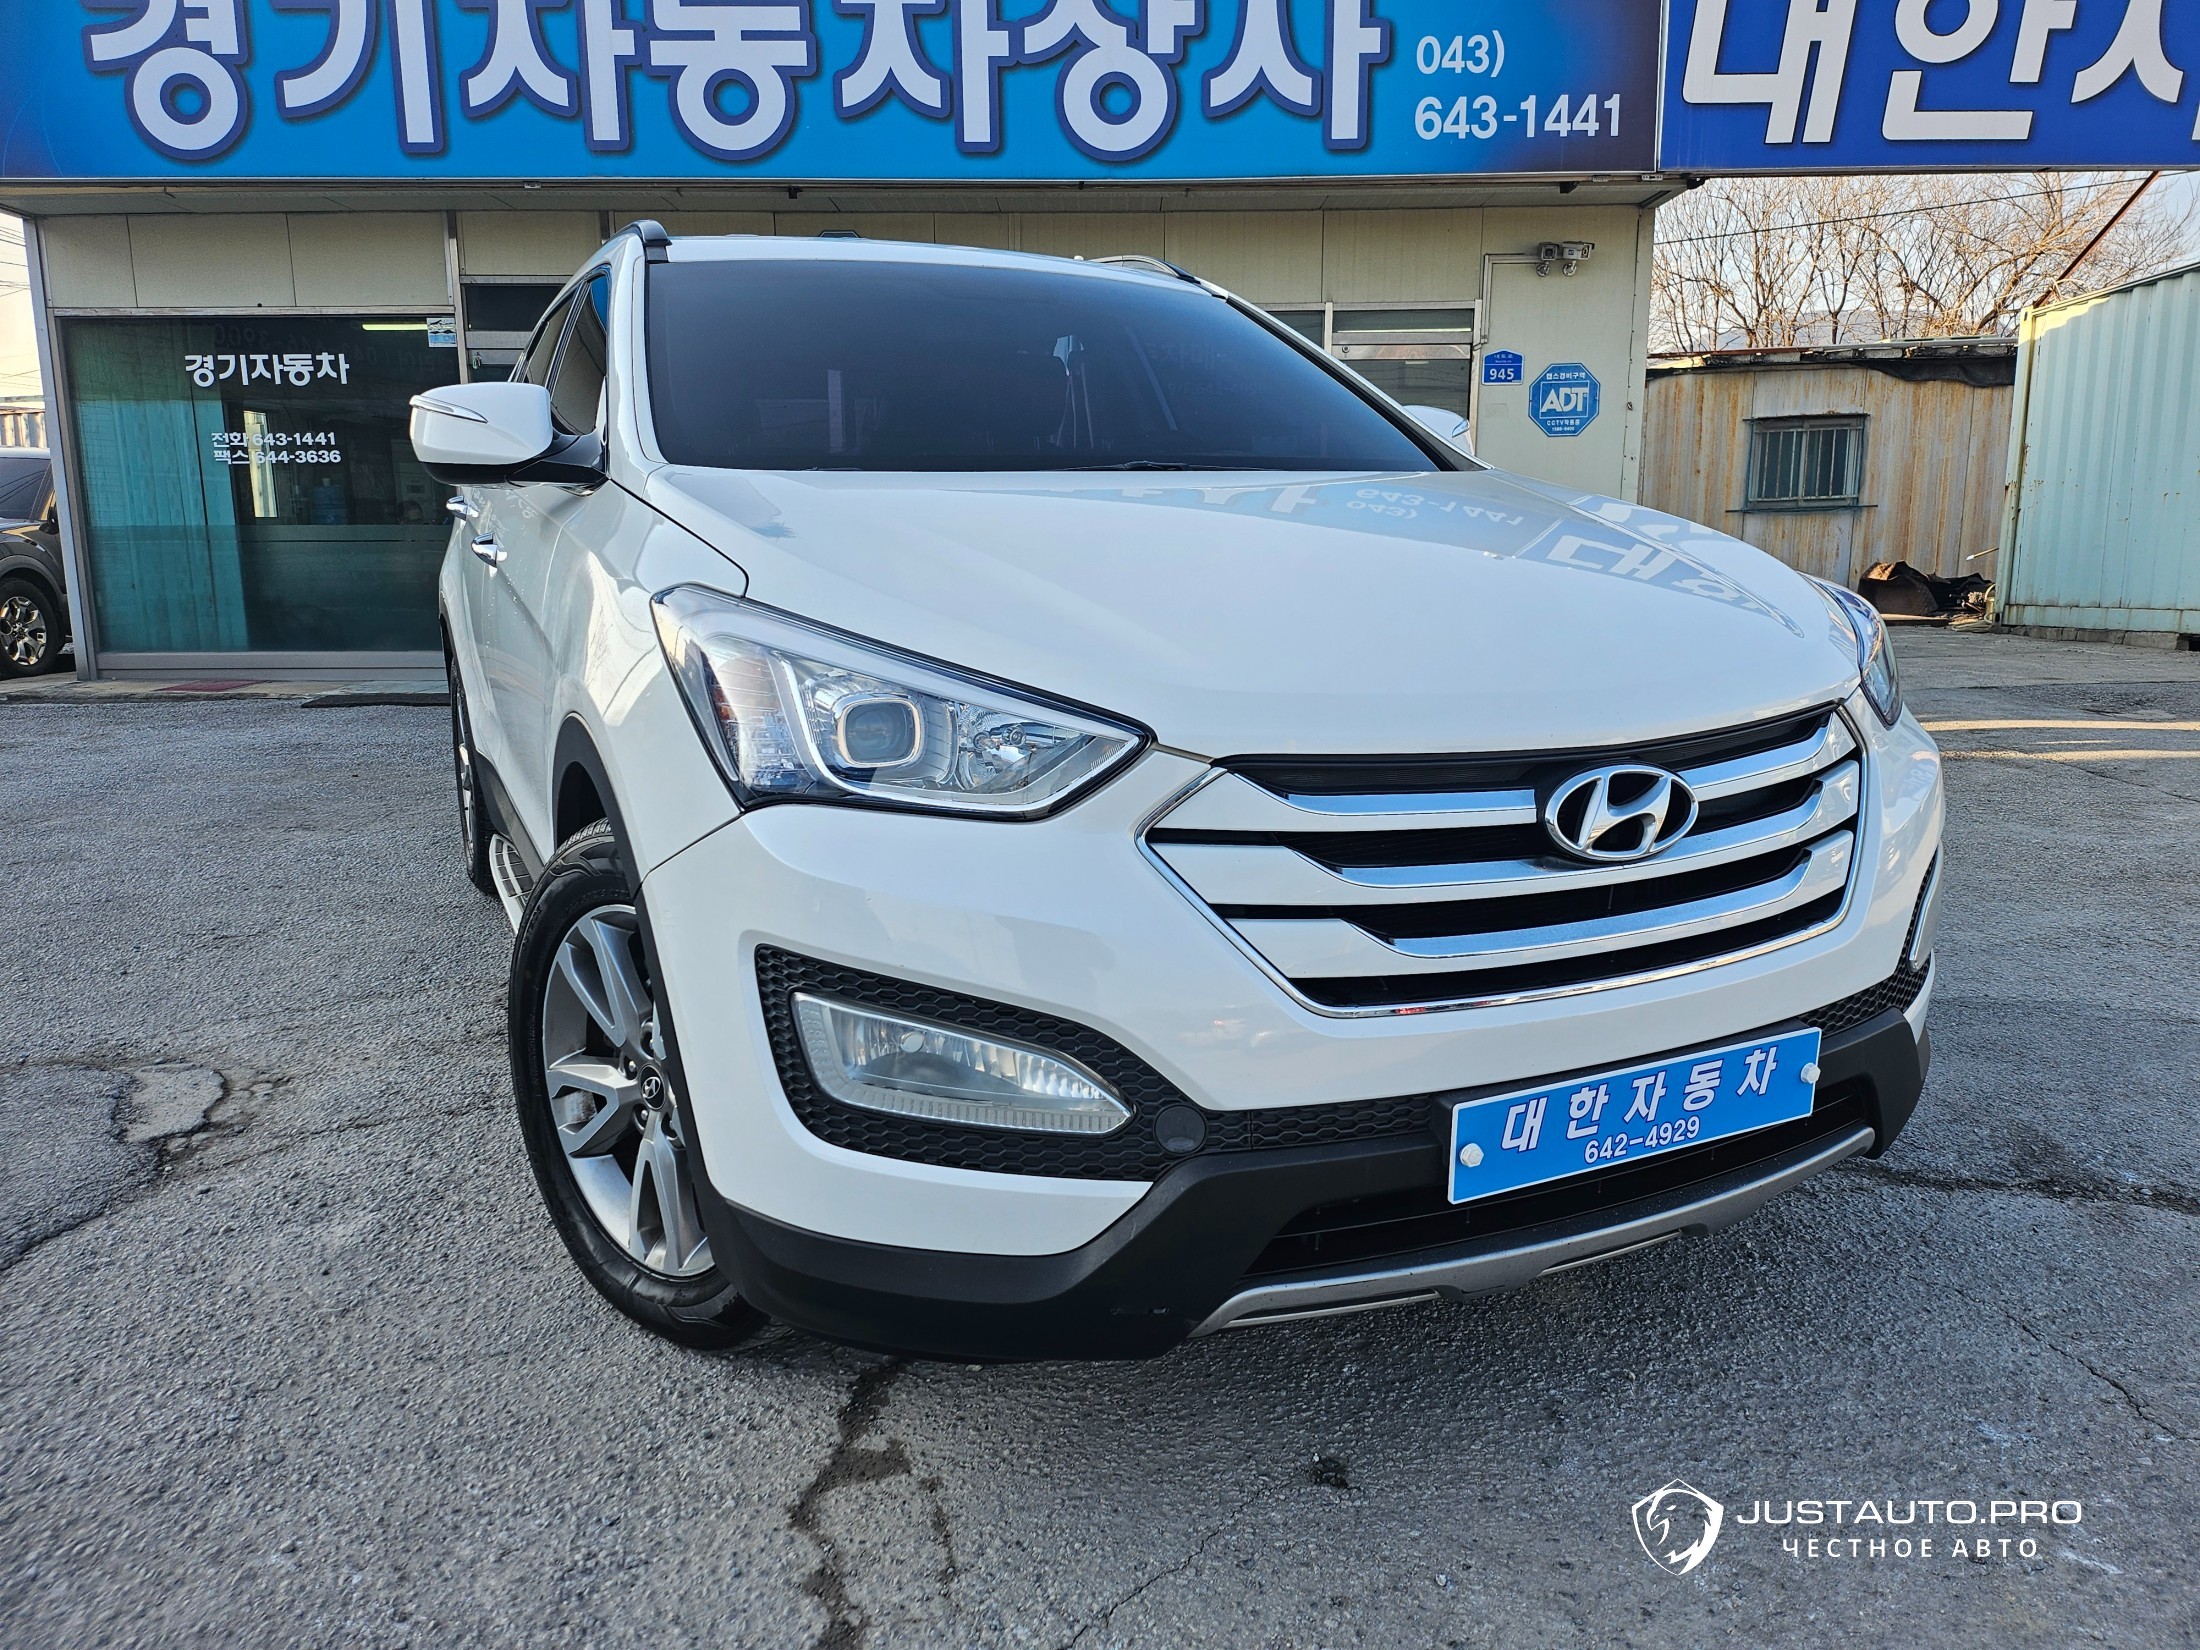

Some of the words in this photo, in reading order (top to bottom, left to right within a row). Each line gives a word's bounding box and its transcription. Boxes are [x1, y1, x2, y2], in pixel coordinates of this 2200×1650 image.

[1416, 29, 1505, 77] 043)
[1414, 94, 1621, 140] 643-1441
[184, 352, 350, 387] 경기자동차
[1489, 368, 1515, 380] 945
[1540, 387, 1589, 413] ADT
[211, 432, 248, 448] 전화
[252, 432, 336, 446] 643-1441
[213, 450, 250, 465] 팩스
[255, 450, 341, 464] 644-3636
[1584, 1115, 1701, 1165] 642-4929
